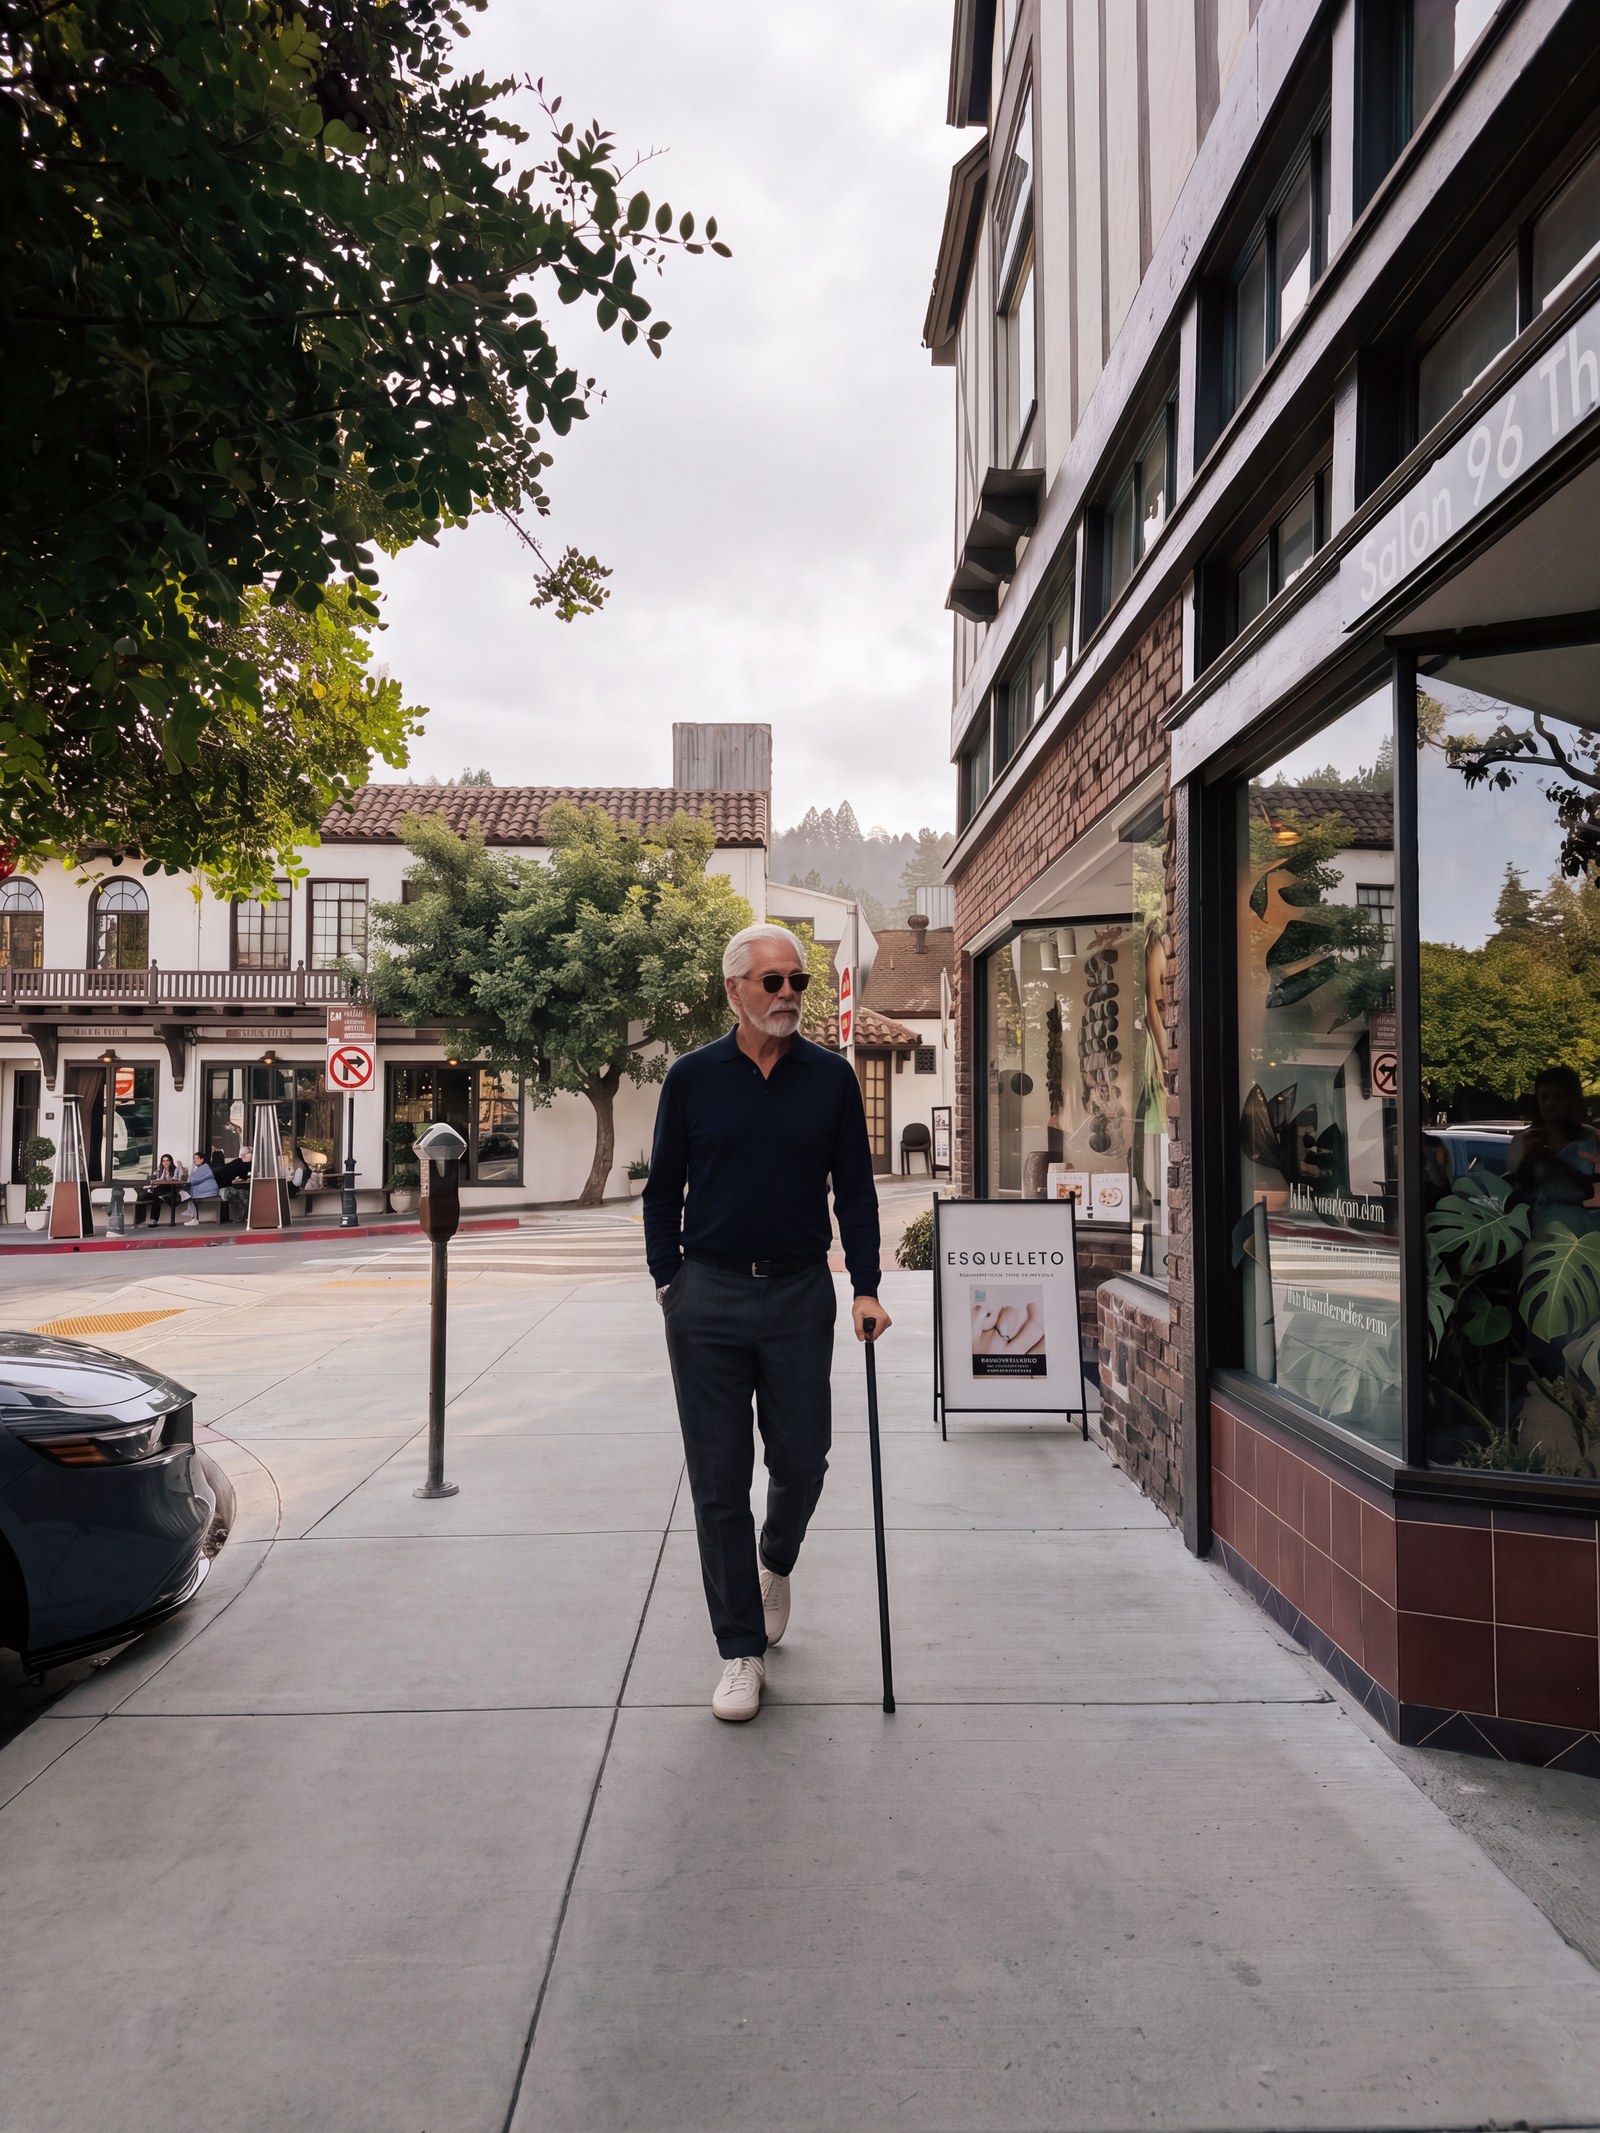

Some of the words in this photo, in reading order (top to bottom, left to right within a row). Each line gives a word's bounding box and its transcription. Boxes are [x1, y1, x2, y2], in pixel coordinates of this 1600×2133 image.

[1360, 488, 1452, 602] Salon
[1467, 395, 1523, 506] 96
[947, 1251, 1064, 1265] ESQUELETO
